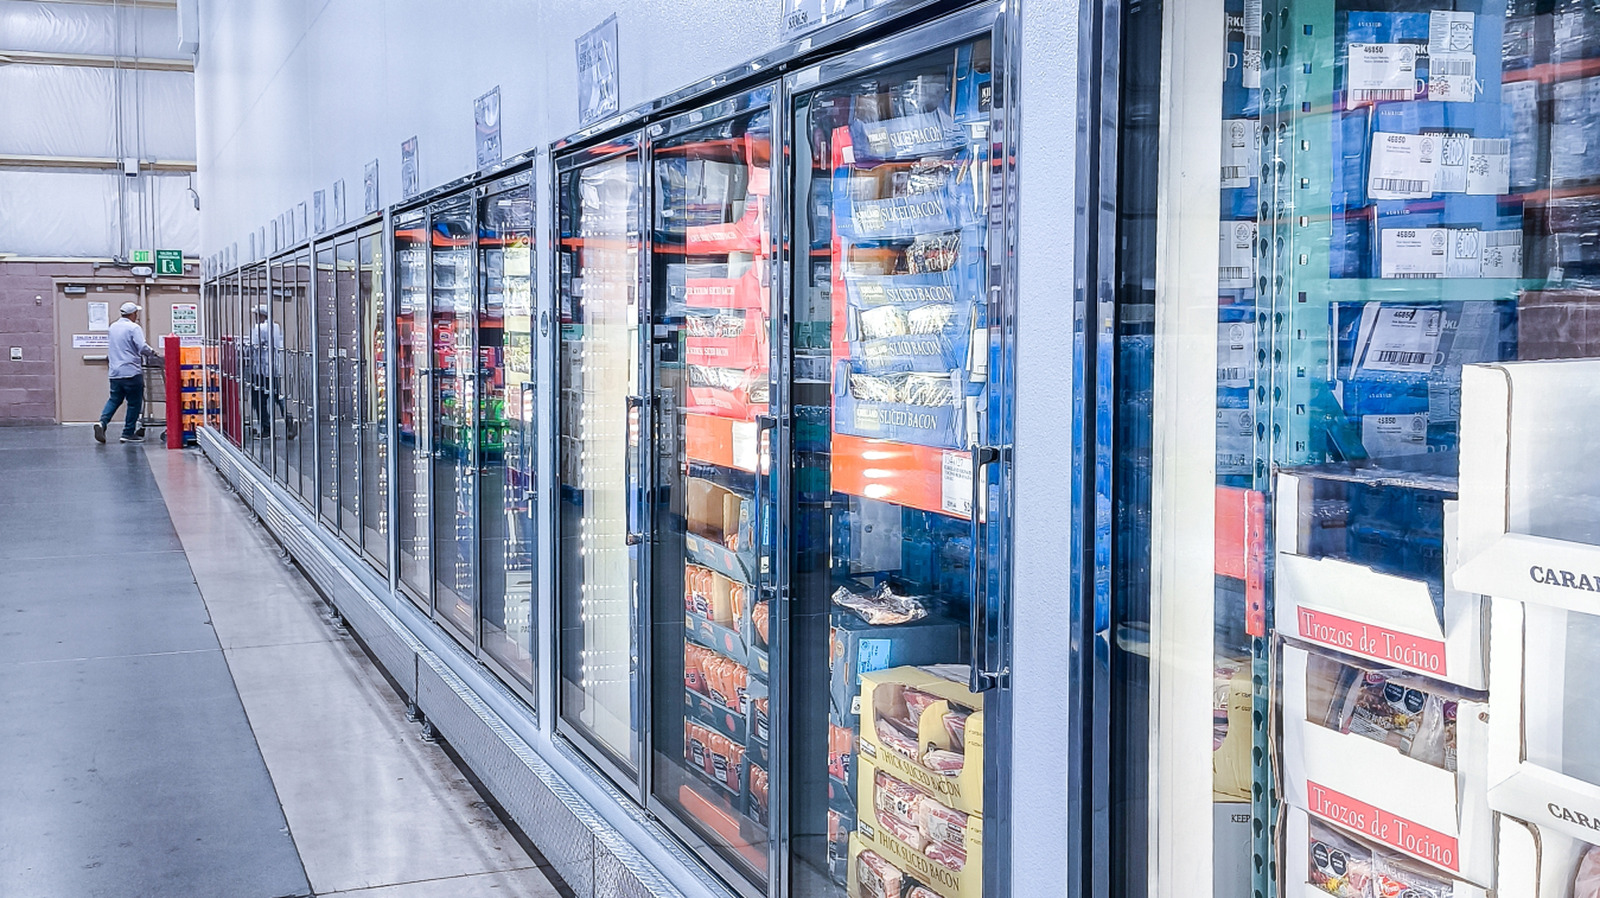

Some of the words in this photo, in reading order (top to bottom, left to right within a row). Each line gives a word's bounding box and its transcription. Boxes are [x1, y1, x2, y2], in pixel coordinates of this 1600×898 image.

[911, 200, 943, 219] BACON
[134, 251, 149, 261] EXIT
[886, 288, 917, 301] SLICED
[917, 286, 953, 301] BACON
[911, 340, 941, 355] BACON
[879, 409, 906, 425] SLICED
[907, 411, 938, 429] BACON
[1301, 611, 1353, 648] Trozos
[1359, 626, 1377, 654] de
[1381, 632, 1439, 671] Tocino
[880, 747, 902, 771] THICK
[902, 759, 931, 786] SLICED
[931, 778, 962, 797] BACON
[1231, 814, 1251, 823] KEEP
[1313, 786, 1365, 829] Trozos
[1371, 810, 1388, 839] de
[1393, 819, 1452, 866] Tocino
[878, 830, 901, 856] THICK
[900, 845, 928, 873] SLICED
[929, 865, 960, 891] BACON
